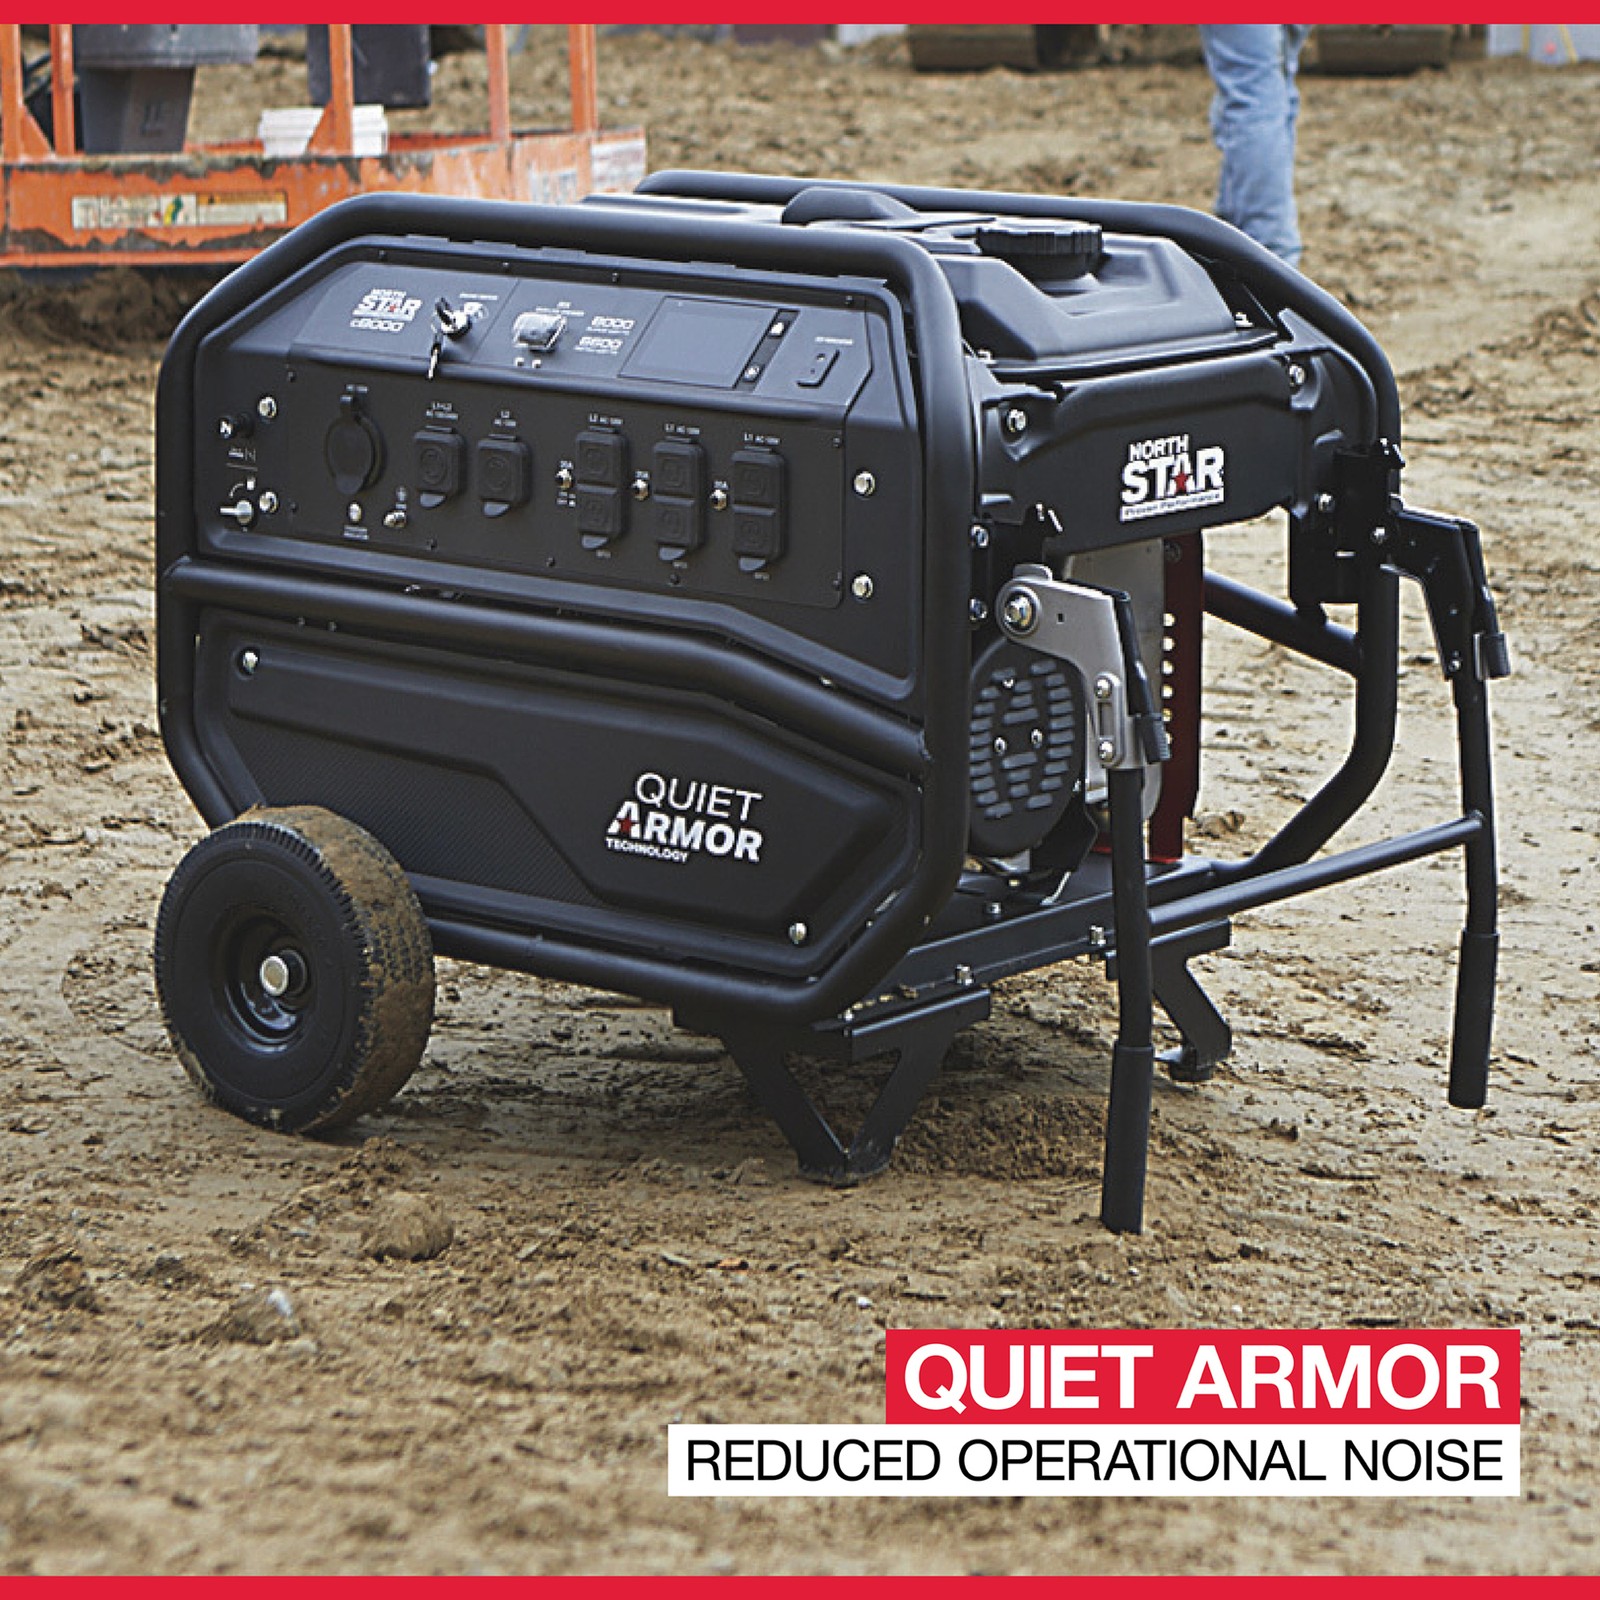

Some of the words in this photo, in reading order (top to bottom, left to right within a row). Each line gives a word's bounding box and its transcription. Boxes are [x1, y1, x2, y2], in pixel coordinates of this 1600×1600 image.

[357, 295, 423, 317] STAR
[1129, 433, 1190, 463] NORTH
[1121, 446, 1225, 504] STAR
[635, 772, 764, 822] QUIET
[605, 836, 690, 863] TECHNOLOGY
[606, 800, 763, 863] ARMOR
